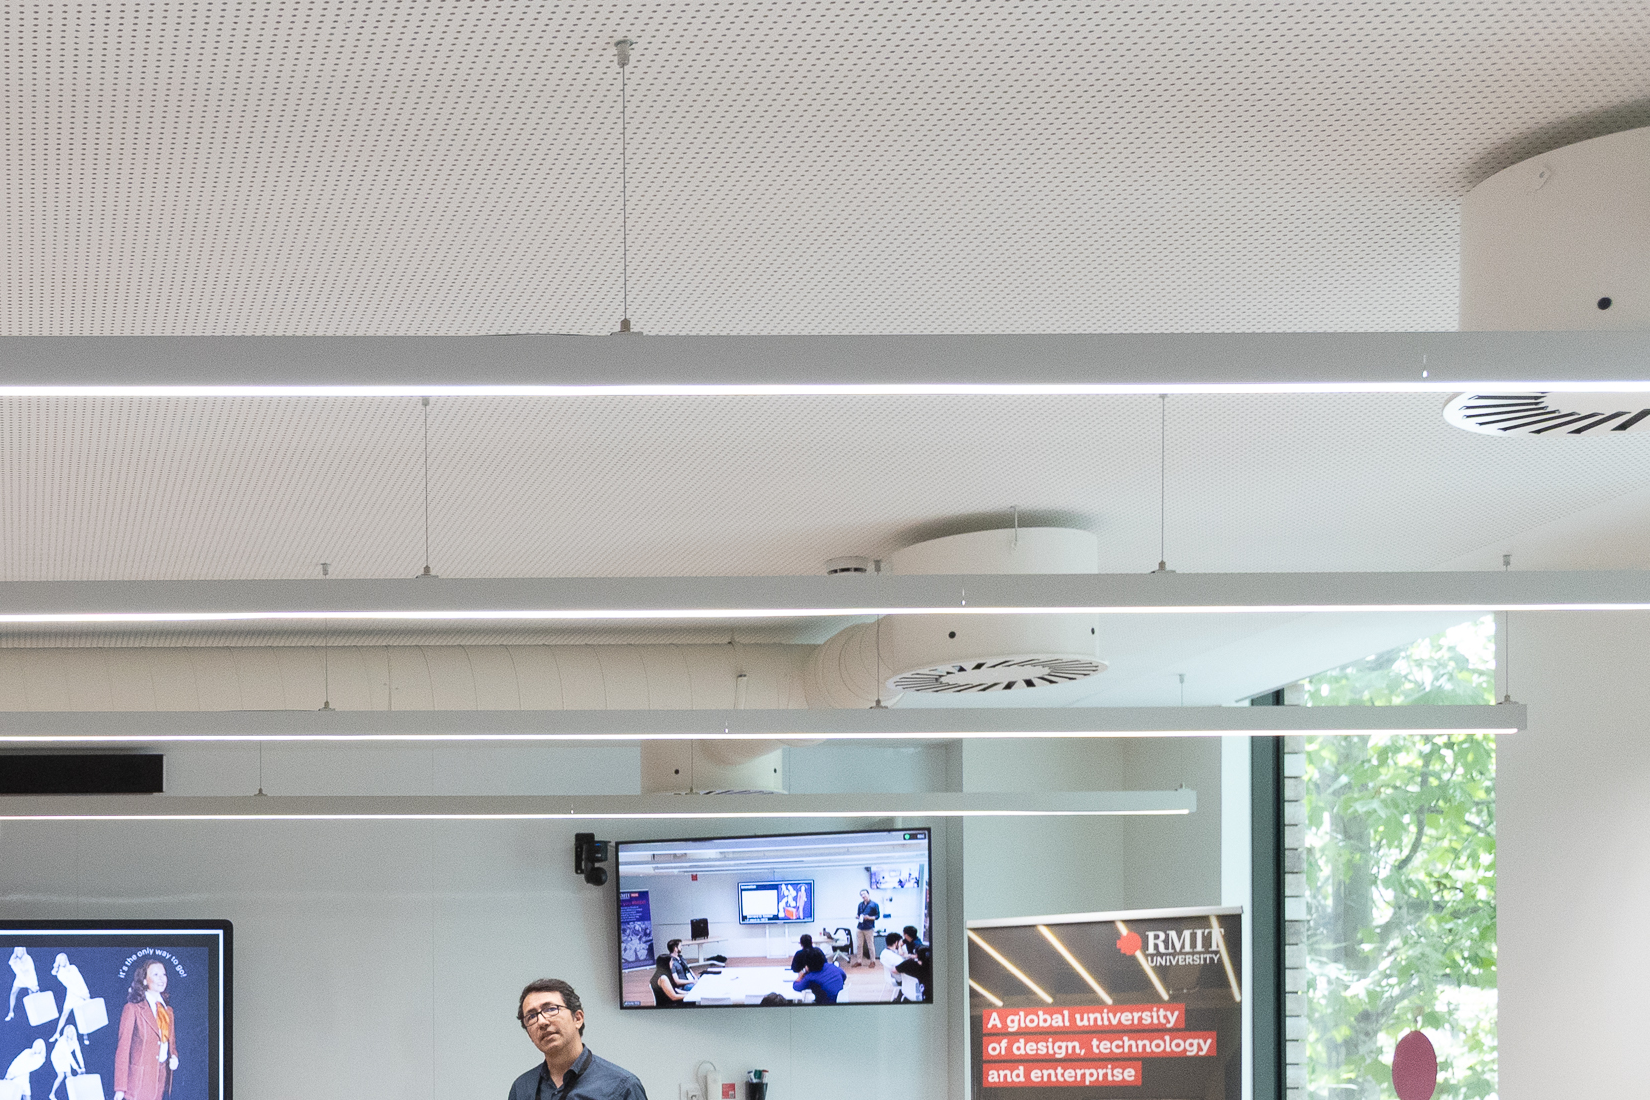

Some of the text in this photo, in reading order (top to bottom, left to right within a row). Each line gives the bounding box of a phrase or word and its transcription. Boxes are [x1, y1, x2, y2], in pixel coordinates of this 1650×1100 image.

[1145, 928, 1225, 955] RMIT
[118, 946, 187, 979] it's the only way to go!
[1147, 954, 1221, 967] UNIVERSITY
[987, 1006, 1179, 1031] A global university
[987, 1035, 1212, 1059] of design, technology
[988, 1064, 1136, 1085] and enterprise
